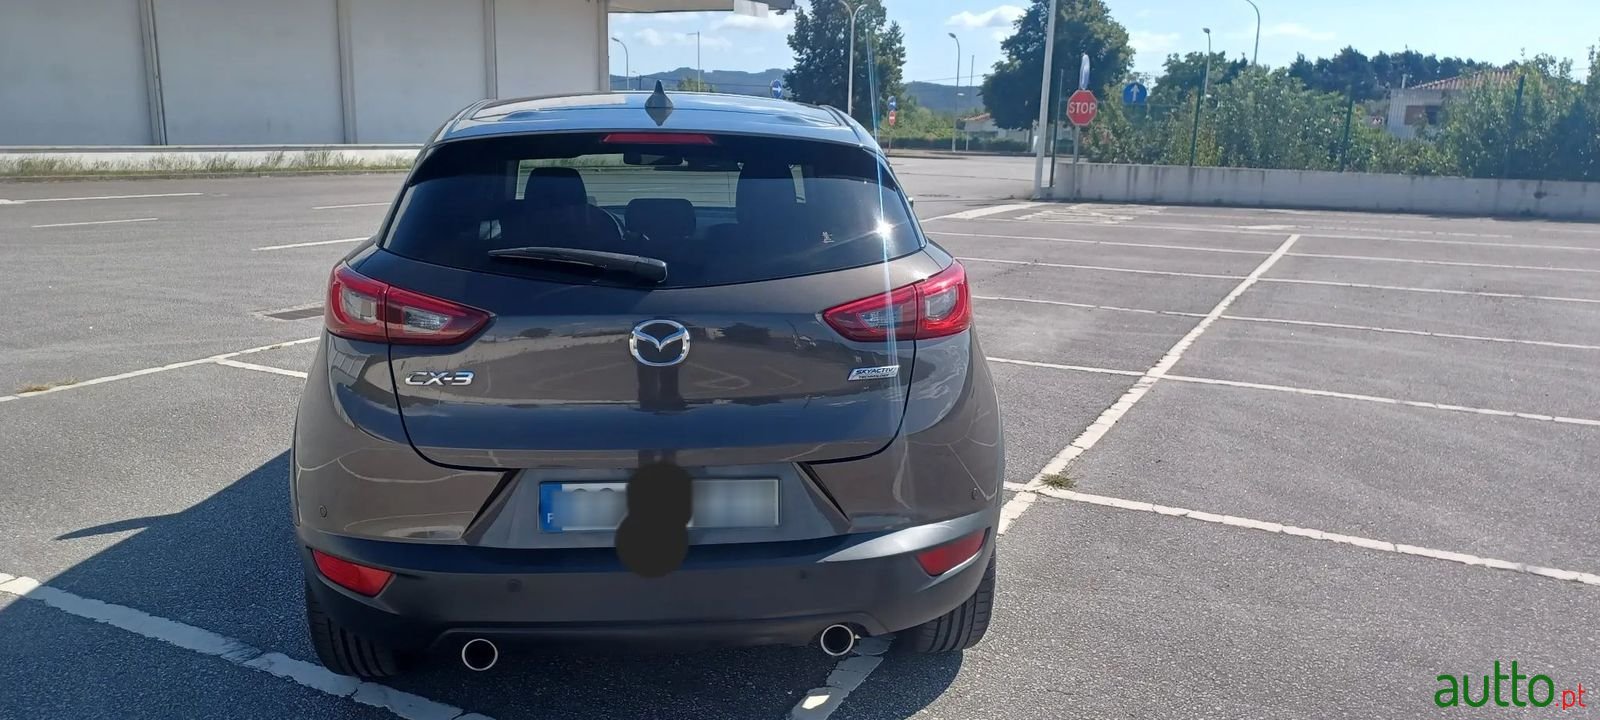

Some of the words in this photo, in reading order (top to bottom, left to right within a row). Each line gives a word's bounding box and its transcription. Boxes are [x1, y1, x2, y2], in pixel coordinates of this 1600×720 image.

[1069, 102, 1096, 114] STOP
[855, 367, 895, 375] SKYACTIV
[405, 371, 474, 386] CX-3
